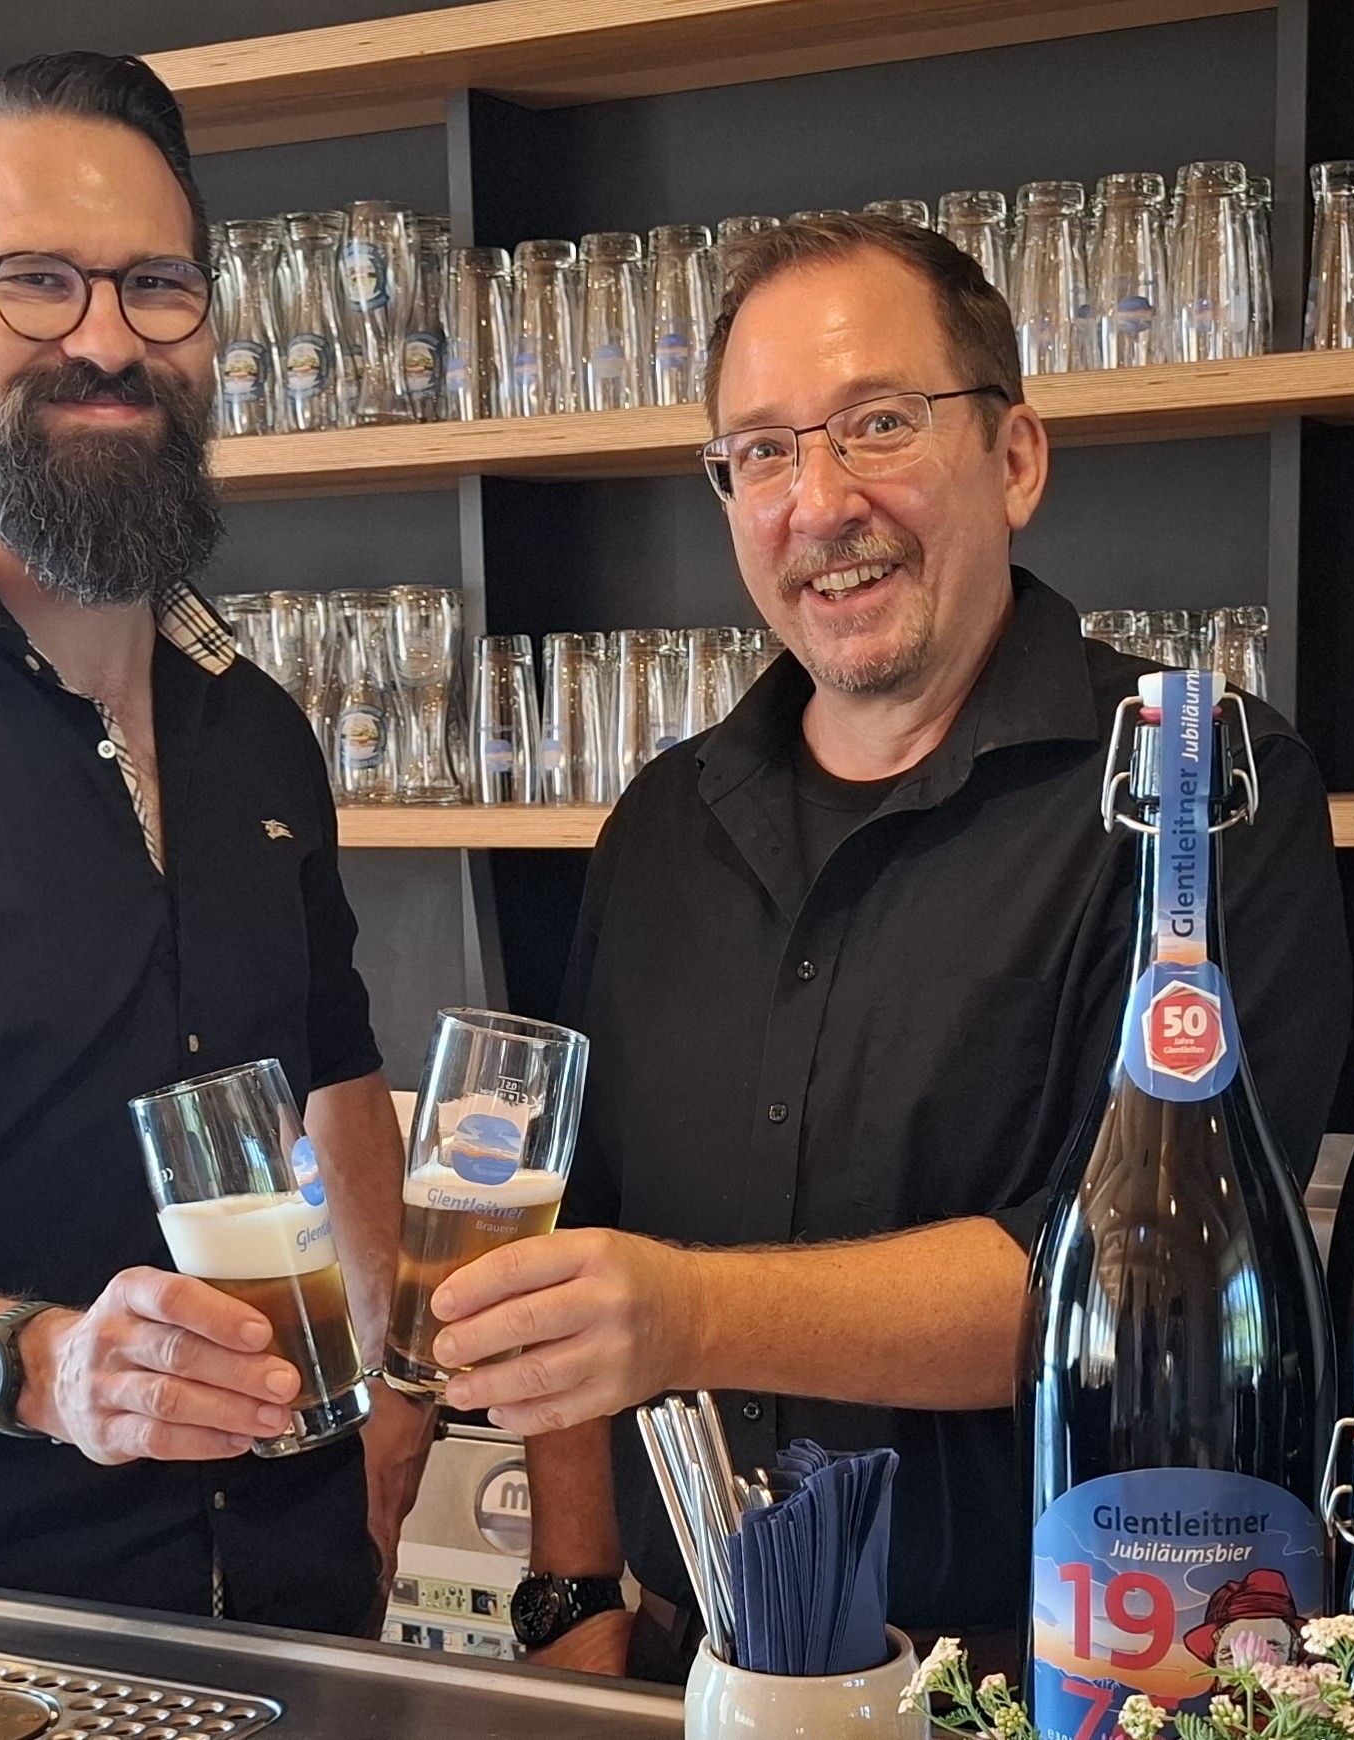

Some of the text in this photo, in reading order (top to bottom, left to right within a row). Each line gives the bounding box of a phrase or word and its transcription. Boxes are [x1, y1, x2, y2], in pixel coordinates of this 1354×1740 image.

[1170, 768, 1198, 938] Glentleitner
[1162, 1005, 1208, 1038] 50
[427, 1187, 527, 1220] Glentleitner
[476, 1219, 520, 1235] Brauerei
[1093, 1505, 1270, 1537] Glentleitner
[1110, 1539, 1253, 1563] Jubiläumsbier
[1058, 1561, 1176, 1671] 19
